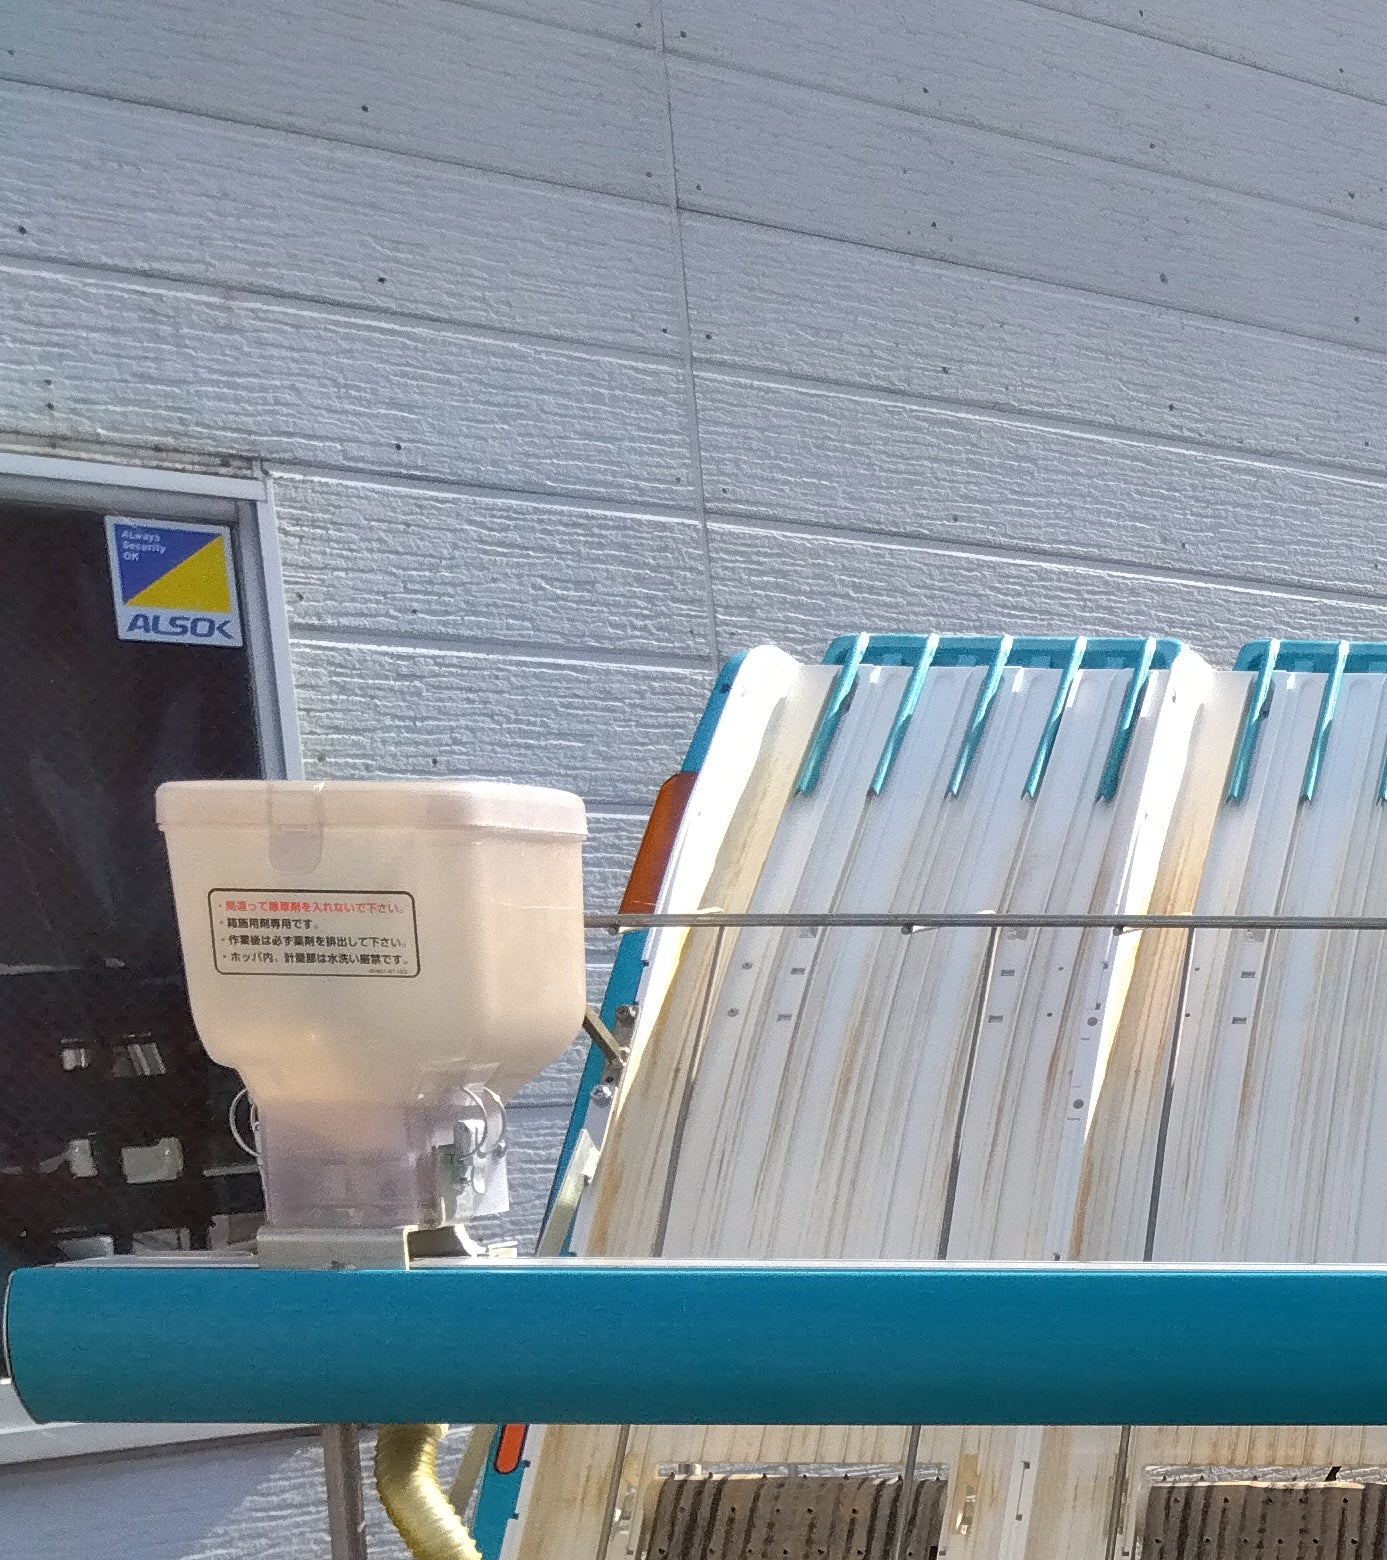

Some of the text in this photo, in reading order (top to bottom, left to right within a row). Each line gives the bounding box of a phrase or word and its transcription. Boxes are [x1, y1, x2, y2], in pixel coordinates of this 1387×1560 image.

[122, 540, 166, 554] Security
[123, 551, 140, 561] OK
[126, 613, 234, 640] ALSOK
